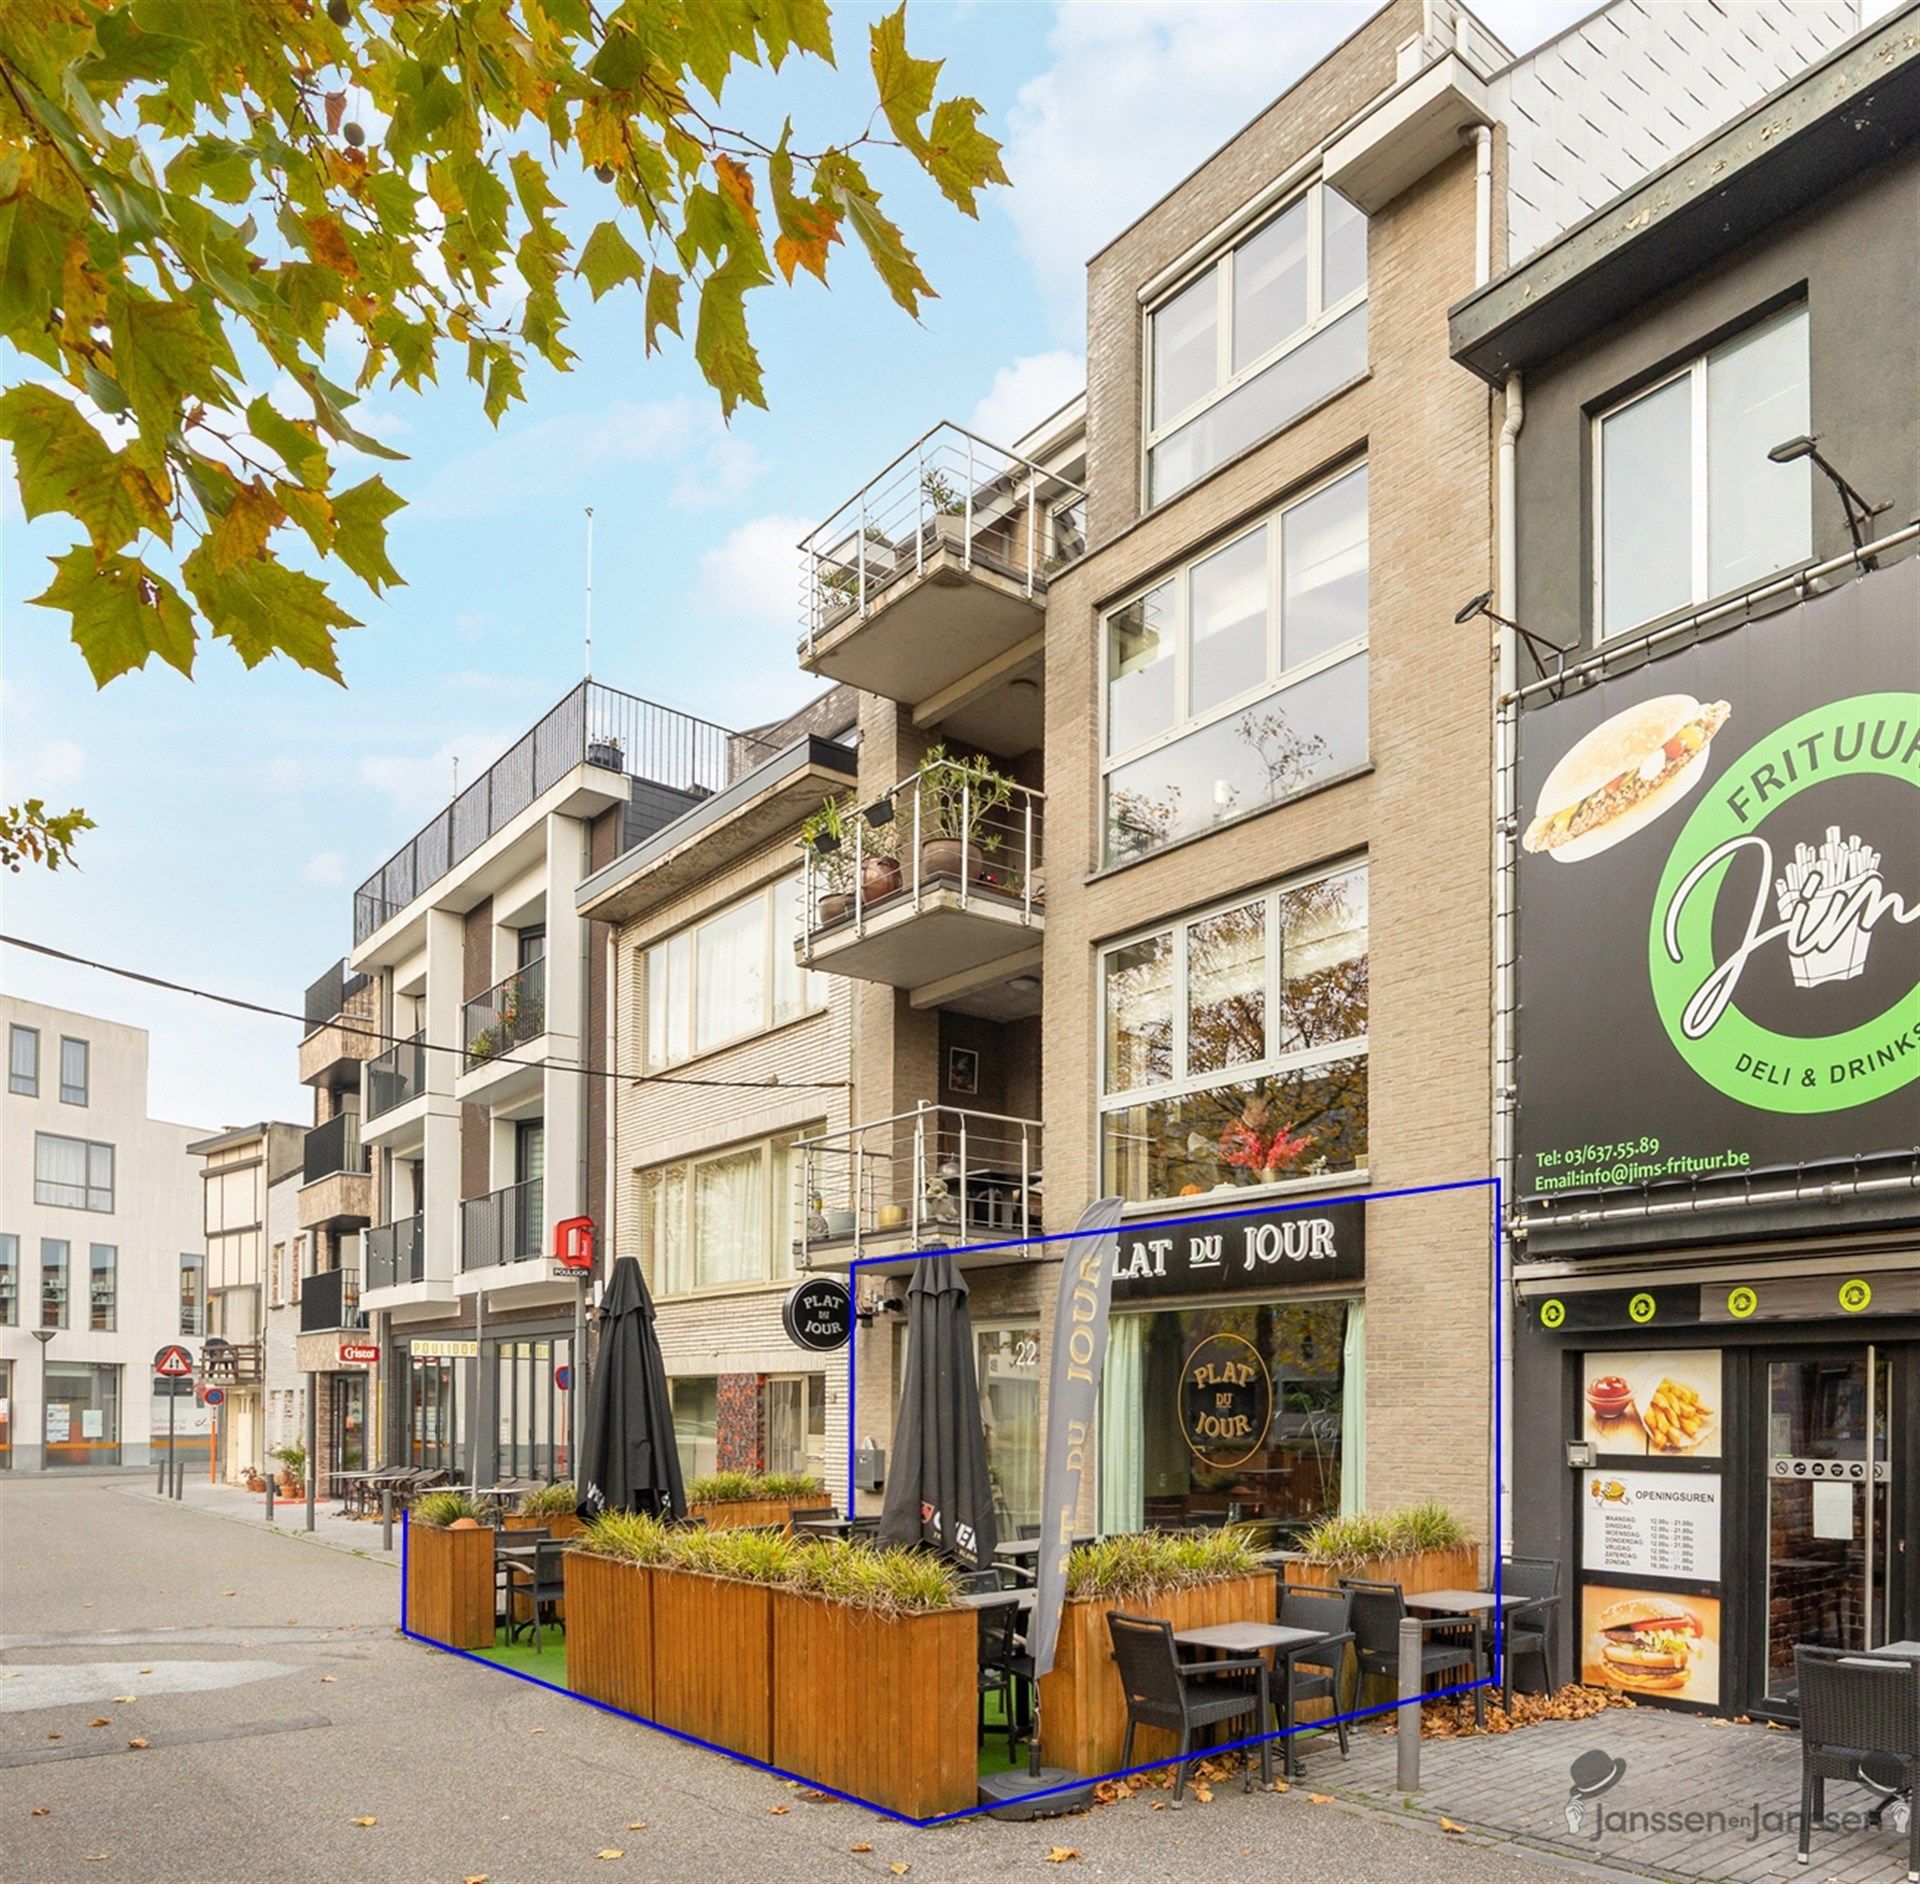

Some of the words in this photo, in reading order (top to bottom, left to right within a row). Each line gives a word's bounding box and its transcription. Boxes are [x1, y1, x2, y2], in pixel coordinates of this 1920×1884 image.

[1735, 1053, 1790, 1086] DELI
[1801, 1068, 1817, 1087] &
[1536, 1149, 1561, 1168] Tel:
[1565, 1137, 1660, 1165] 03/637.55.89
[1535, 1149, 1750, 1191] Email:info@jims-frituur.be
[1112, 1240, 1172, 1280] LAT
[1189, 1235, 1223, 1268] DU
[1244, 1218, 1337, 1271] JOUR
[803, 1295, 845, 1310] PLAT
[804, 1320, 843, 1335] JOUR
[1067, 1253, 1102, 1385] JOUR
[344, 1347, 376, 1360] Cristal
[1016, 1341, 1036, 1365] 22
[1193, 1361, 1255, 1389] PLAT
[1215, 1393, 1233, 1408] DU
[1195, 1411, 1252, 1438] JOUR
[1066, 1418, 1088, 1472] DU
[1635, 1490, 1715, 1503] OPENINGSUREN
